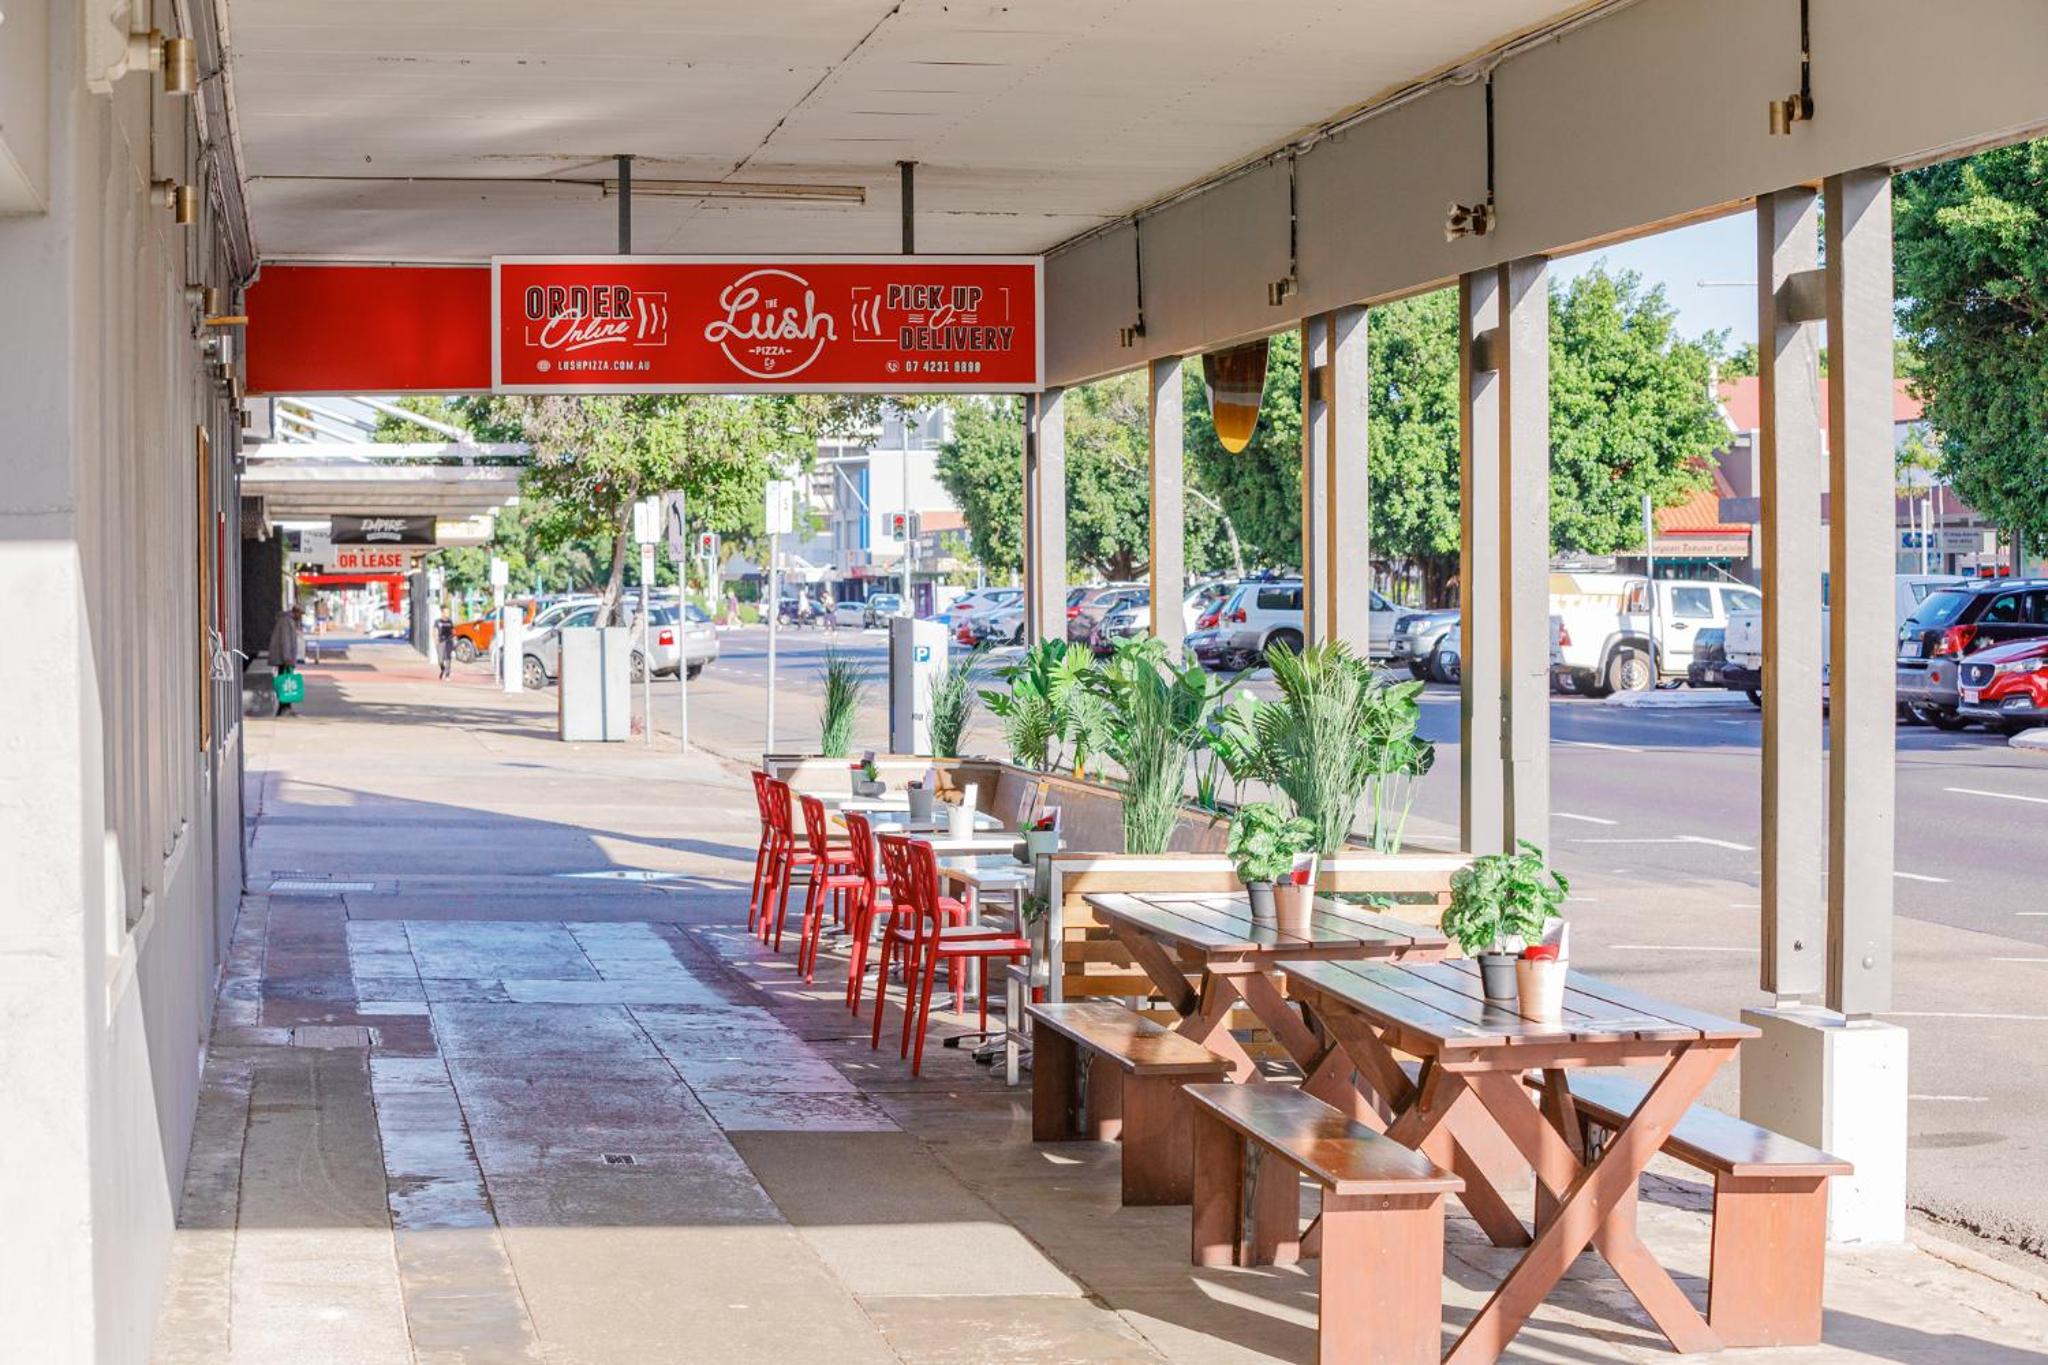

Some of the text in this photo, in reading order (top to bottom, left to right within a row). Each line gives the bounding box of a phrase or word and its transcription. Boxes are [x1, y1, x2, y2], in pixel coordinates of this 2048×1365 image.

[525, 285, 632, 320] ORDER
[765, 298, 778, 309] THE
[887, 284, 983, 312] PICK UP
[704, 287, 838, 342] Lush
[540, 308, 630, 351] Online
[900, 326, 1015, 351] DELIVERY
[755, 346, 785, 356] PIZZA
[557, 360, 651, 371] LUSHPIZZA.COM.AU
[905, 360, 919, 373] 07
[922, 360, 950, 373] 4231
[361, 554, 402, 567] LEASE
